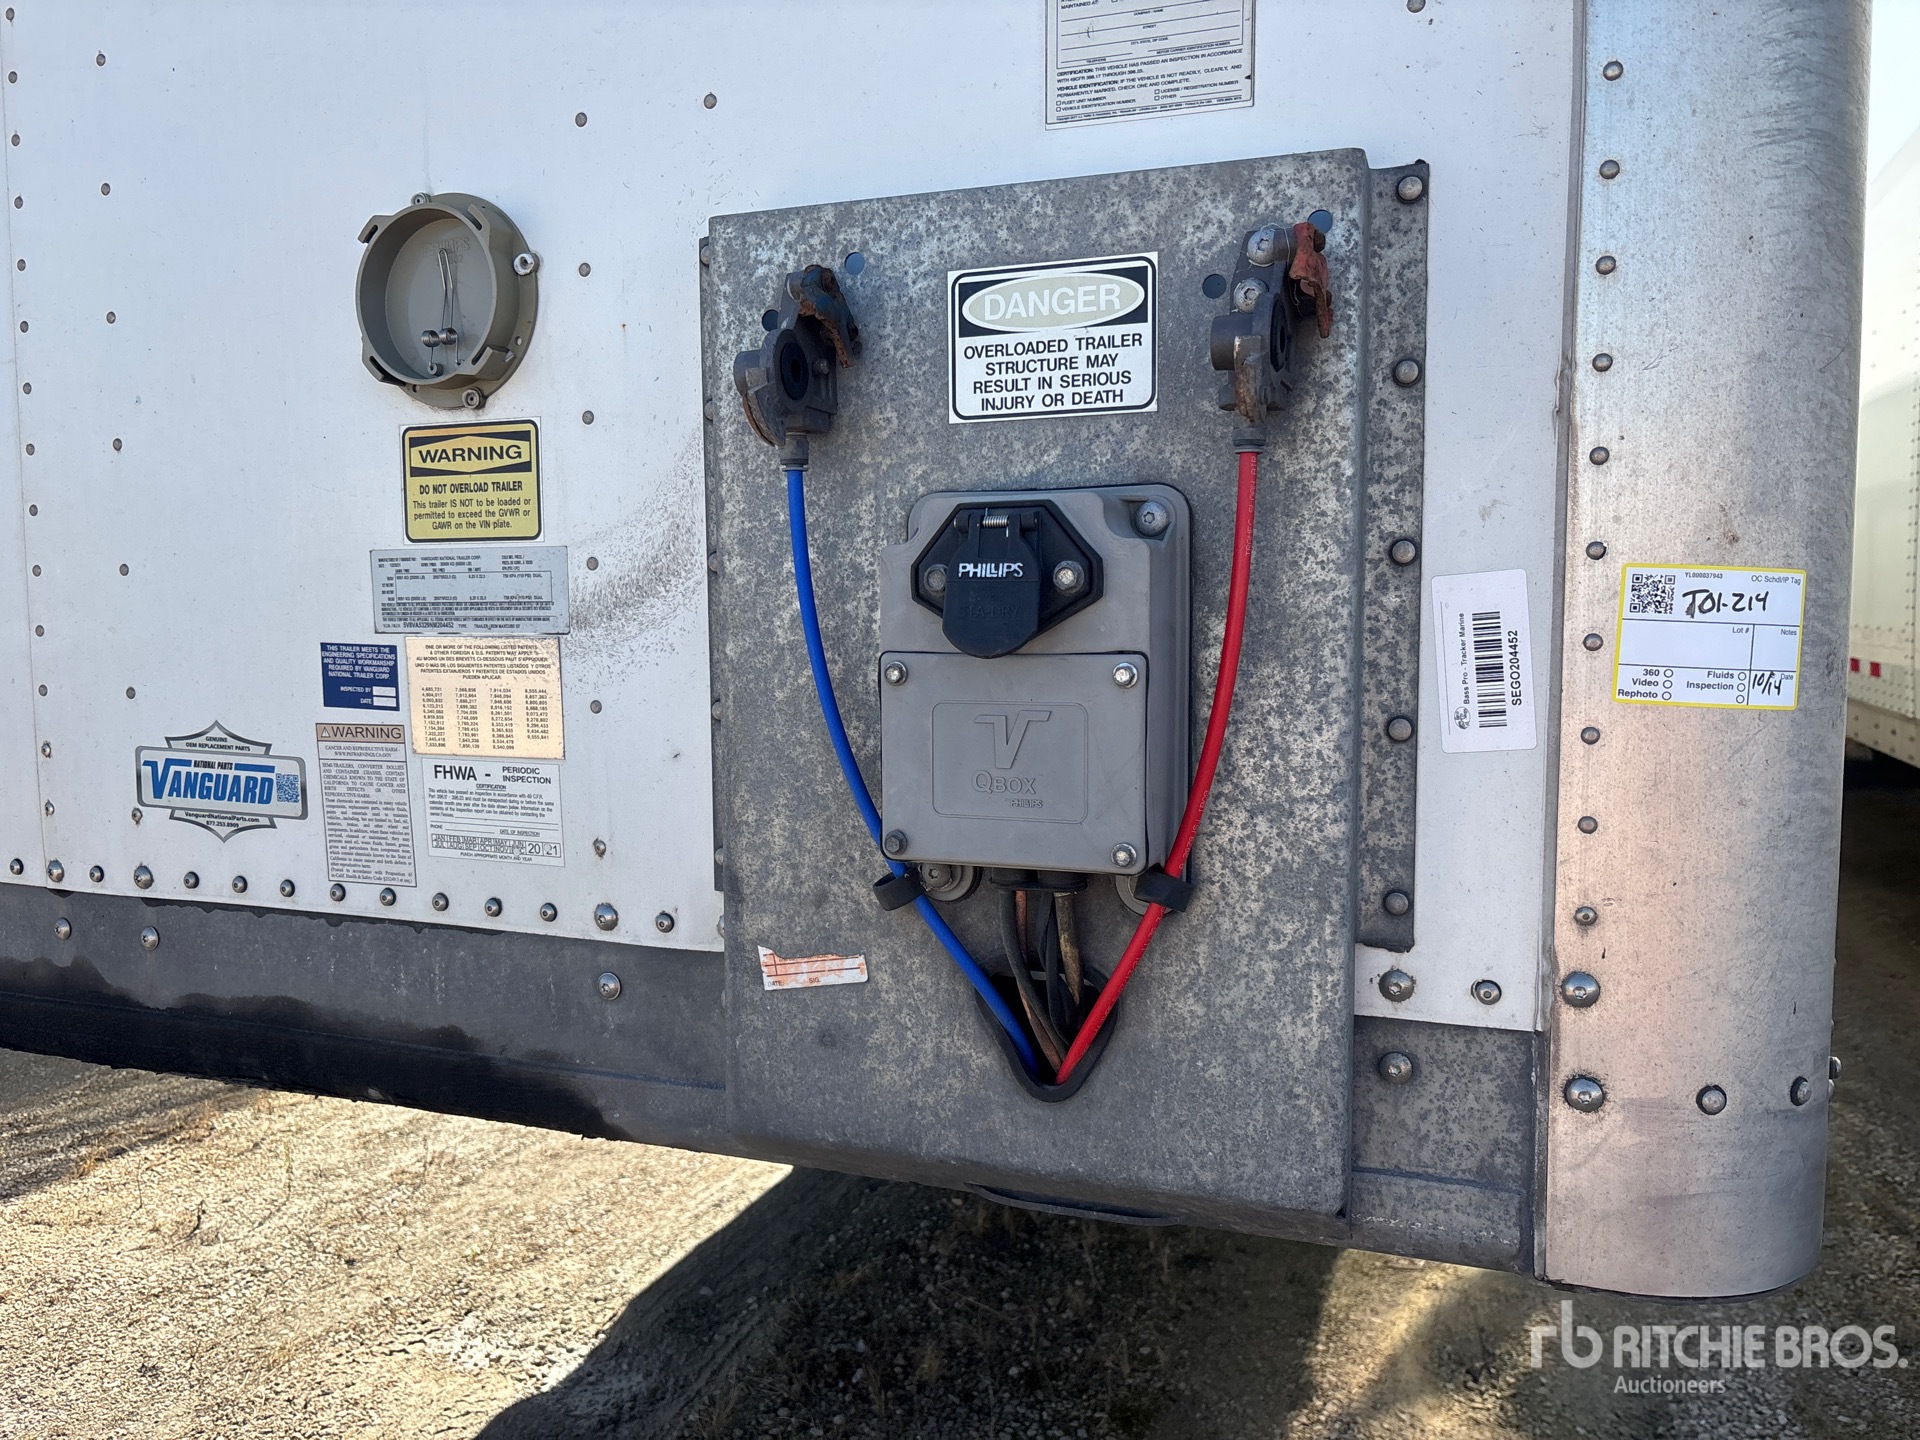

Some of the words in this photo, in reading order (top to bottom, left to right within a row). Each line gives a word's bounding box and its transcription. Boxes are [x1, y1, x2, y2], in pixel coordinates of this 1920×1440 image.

[1057, 68, 1094, 77] CERTIFICATION:
[1169, 54, 1199, 62] INSPECTION
[1207, 49, 1242, 58] ACCORDANCE
[1079, 80, 1118, 89] IDENTIFICATION:
[1057, 89, 1093, 98] PERMANENTLY
[984, 284, 1121, 321] DANGER
[964, 339, 1068, 359] OVERLOADED
[1076, 333, 1142, 351] TRAILER
[986, 357, 1078, 376] STRUCTURE
[1087, 353, 1118, 368] MAY
[973, 378, 1031, 394] RESULT
[1038, 376, 1052, 389] IN
[1060, 371, 1131, 388] SERIOUS
[981, 395, 1035, 411] INJURY
[1042, 394, 1064, 407] OR
[1072, 389, 1123, 405] DEATH
[419, 444, 521, 463] WARNING
[420, 485, 430, 495] DO
[433, 484, 447, 494] NOT
[450, 482, 488, 494] OVERLOAD
[492, 481, 522, 492] TRAILER
[413, 501, 426, 509] This
[429, 500, 447, 508] trailer
[450, 499, 457, 508] IS
[460, 499, 473, 507] NOT
[476, 499, 483, 507] to
[486, 498, 495, 507] be
[498, 498, 520, 506] loaded
[414, 511, 445, 521] permitted
[458, 509, 482, 518] exceed
[485, 509, 496, 517] the
[499, 508, 520, 517] GVWR
[432, 521, 452, 530] GAWR
[466, 521, 476, 529] the
[479, 520, 490, 529] VIN
[493, 519, 512, 530] plate.
[958, 562, 1023, 578] PHILLIPS
[1790, 577, 1801, 585] Tag
[1733, 626, 1744, 634] Lot
[1707, 671, 1734, 679] Fluids
[1781, 673, 1793, 681] Date
[1632, 678, 1659, 687] Video
[1687, 681, 1734, 692] Inspection
[1618, 689, 1658, 699] Rephoto
[332, 726, 401, 739] WARNING
[194, 760, 216, 769] NATIONAL
[217, 761, 233, 770] PARTS
[502, 766, 540, 775] PERIODIC
[434, 765, 477, 781] FHWA
[143, 758, 274, 804] VANGUARD
[503, 775, 551, 784] INSPECTION
[185, 811, 259, 823] VanguardNationalParts.com
[528, 844, 540, 854] 20
